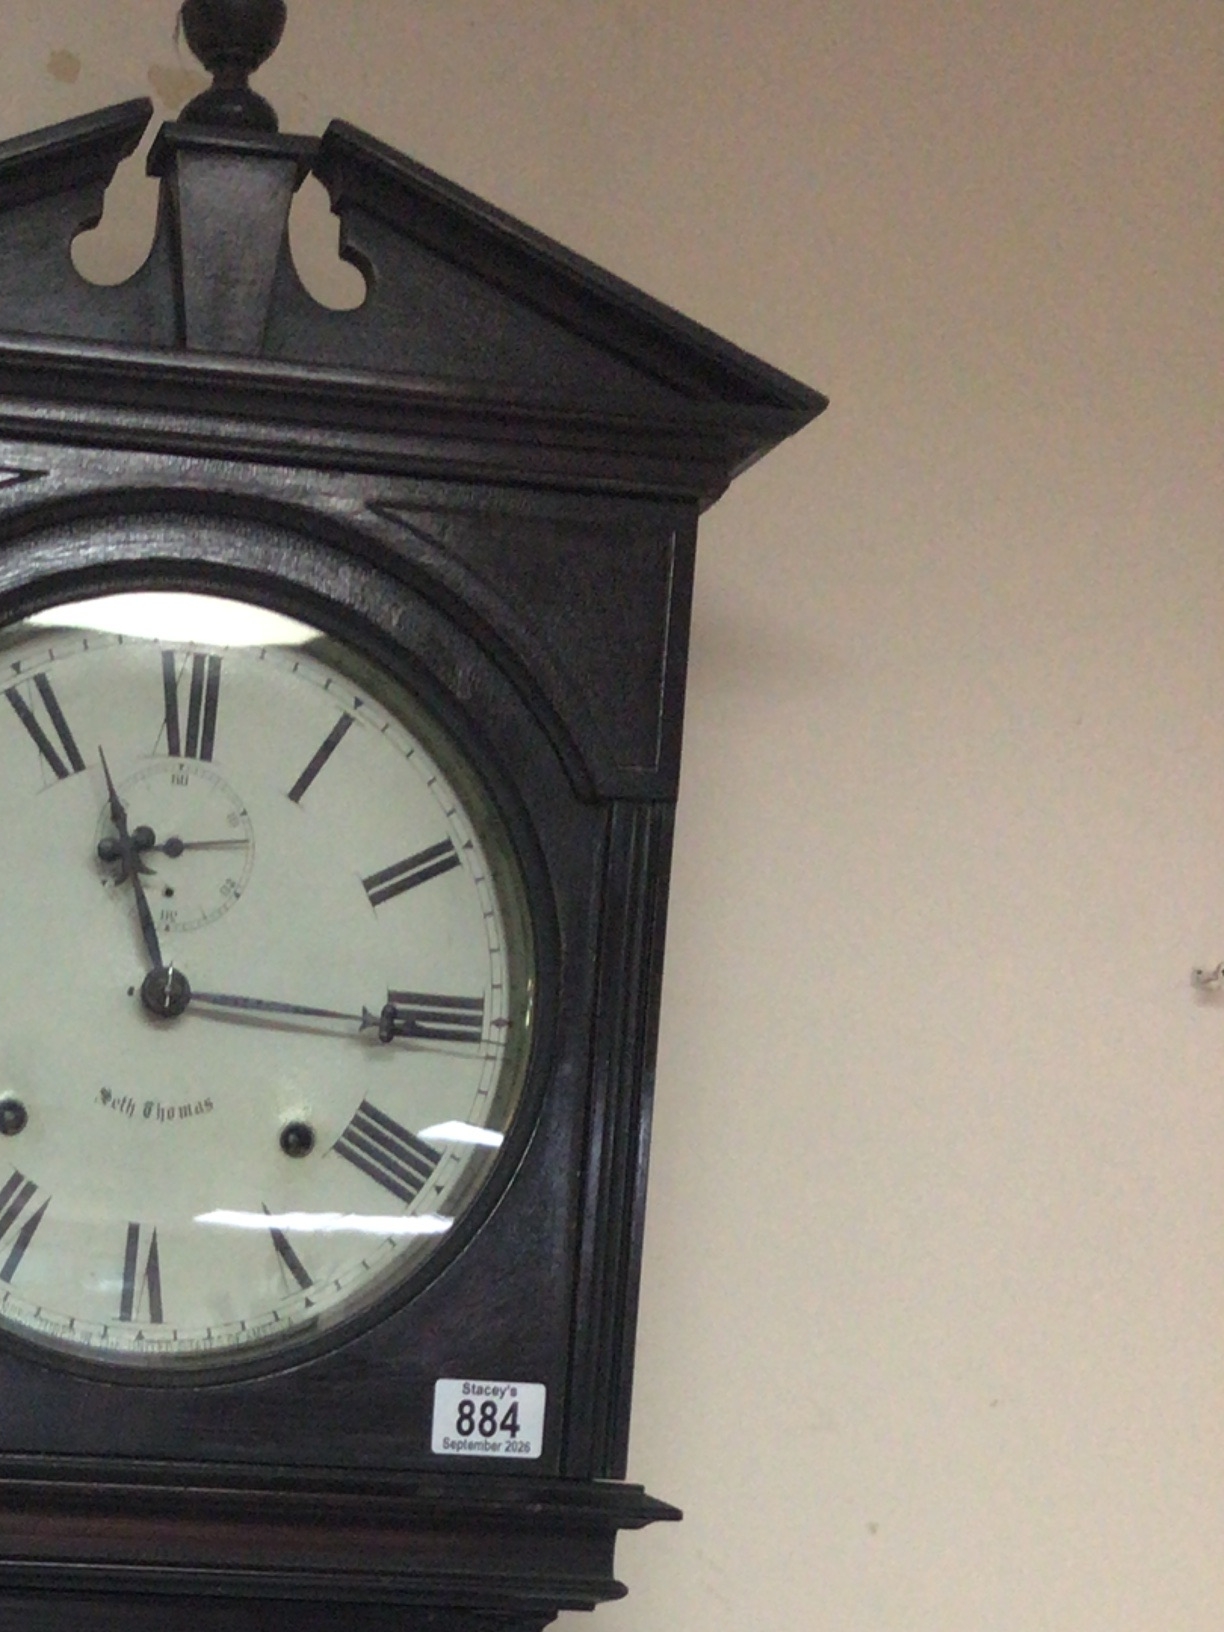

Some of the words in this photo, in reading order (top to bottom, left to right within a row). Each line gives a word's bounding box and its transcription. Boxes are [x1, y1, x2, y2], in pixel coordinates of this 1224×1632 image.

[0, 671, 86, 786] XI
[151, 648, 223, 762] XII
[286, 709, 360, 806] I
[360, 837, 462, 910] II
[386, 988, 486, 1043] III
[142, 1097, 214, 1122] Thomas
[330, 1096, 446, 1204] IIII
[116, 1222, 165, 1325] VI
[455, 1398, 521, 1439] 884
[462, 1381, 518, 1400] Stacey's
[442, 1436, 502, 1453] September
